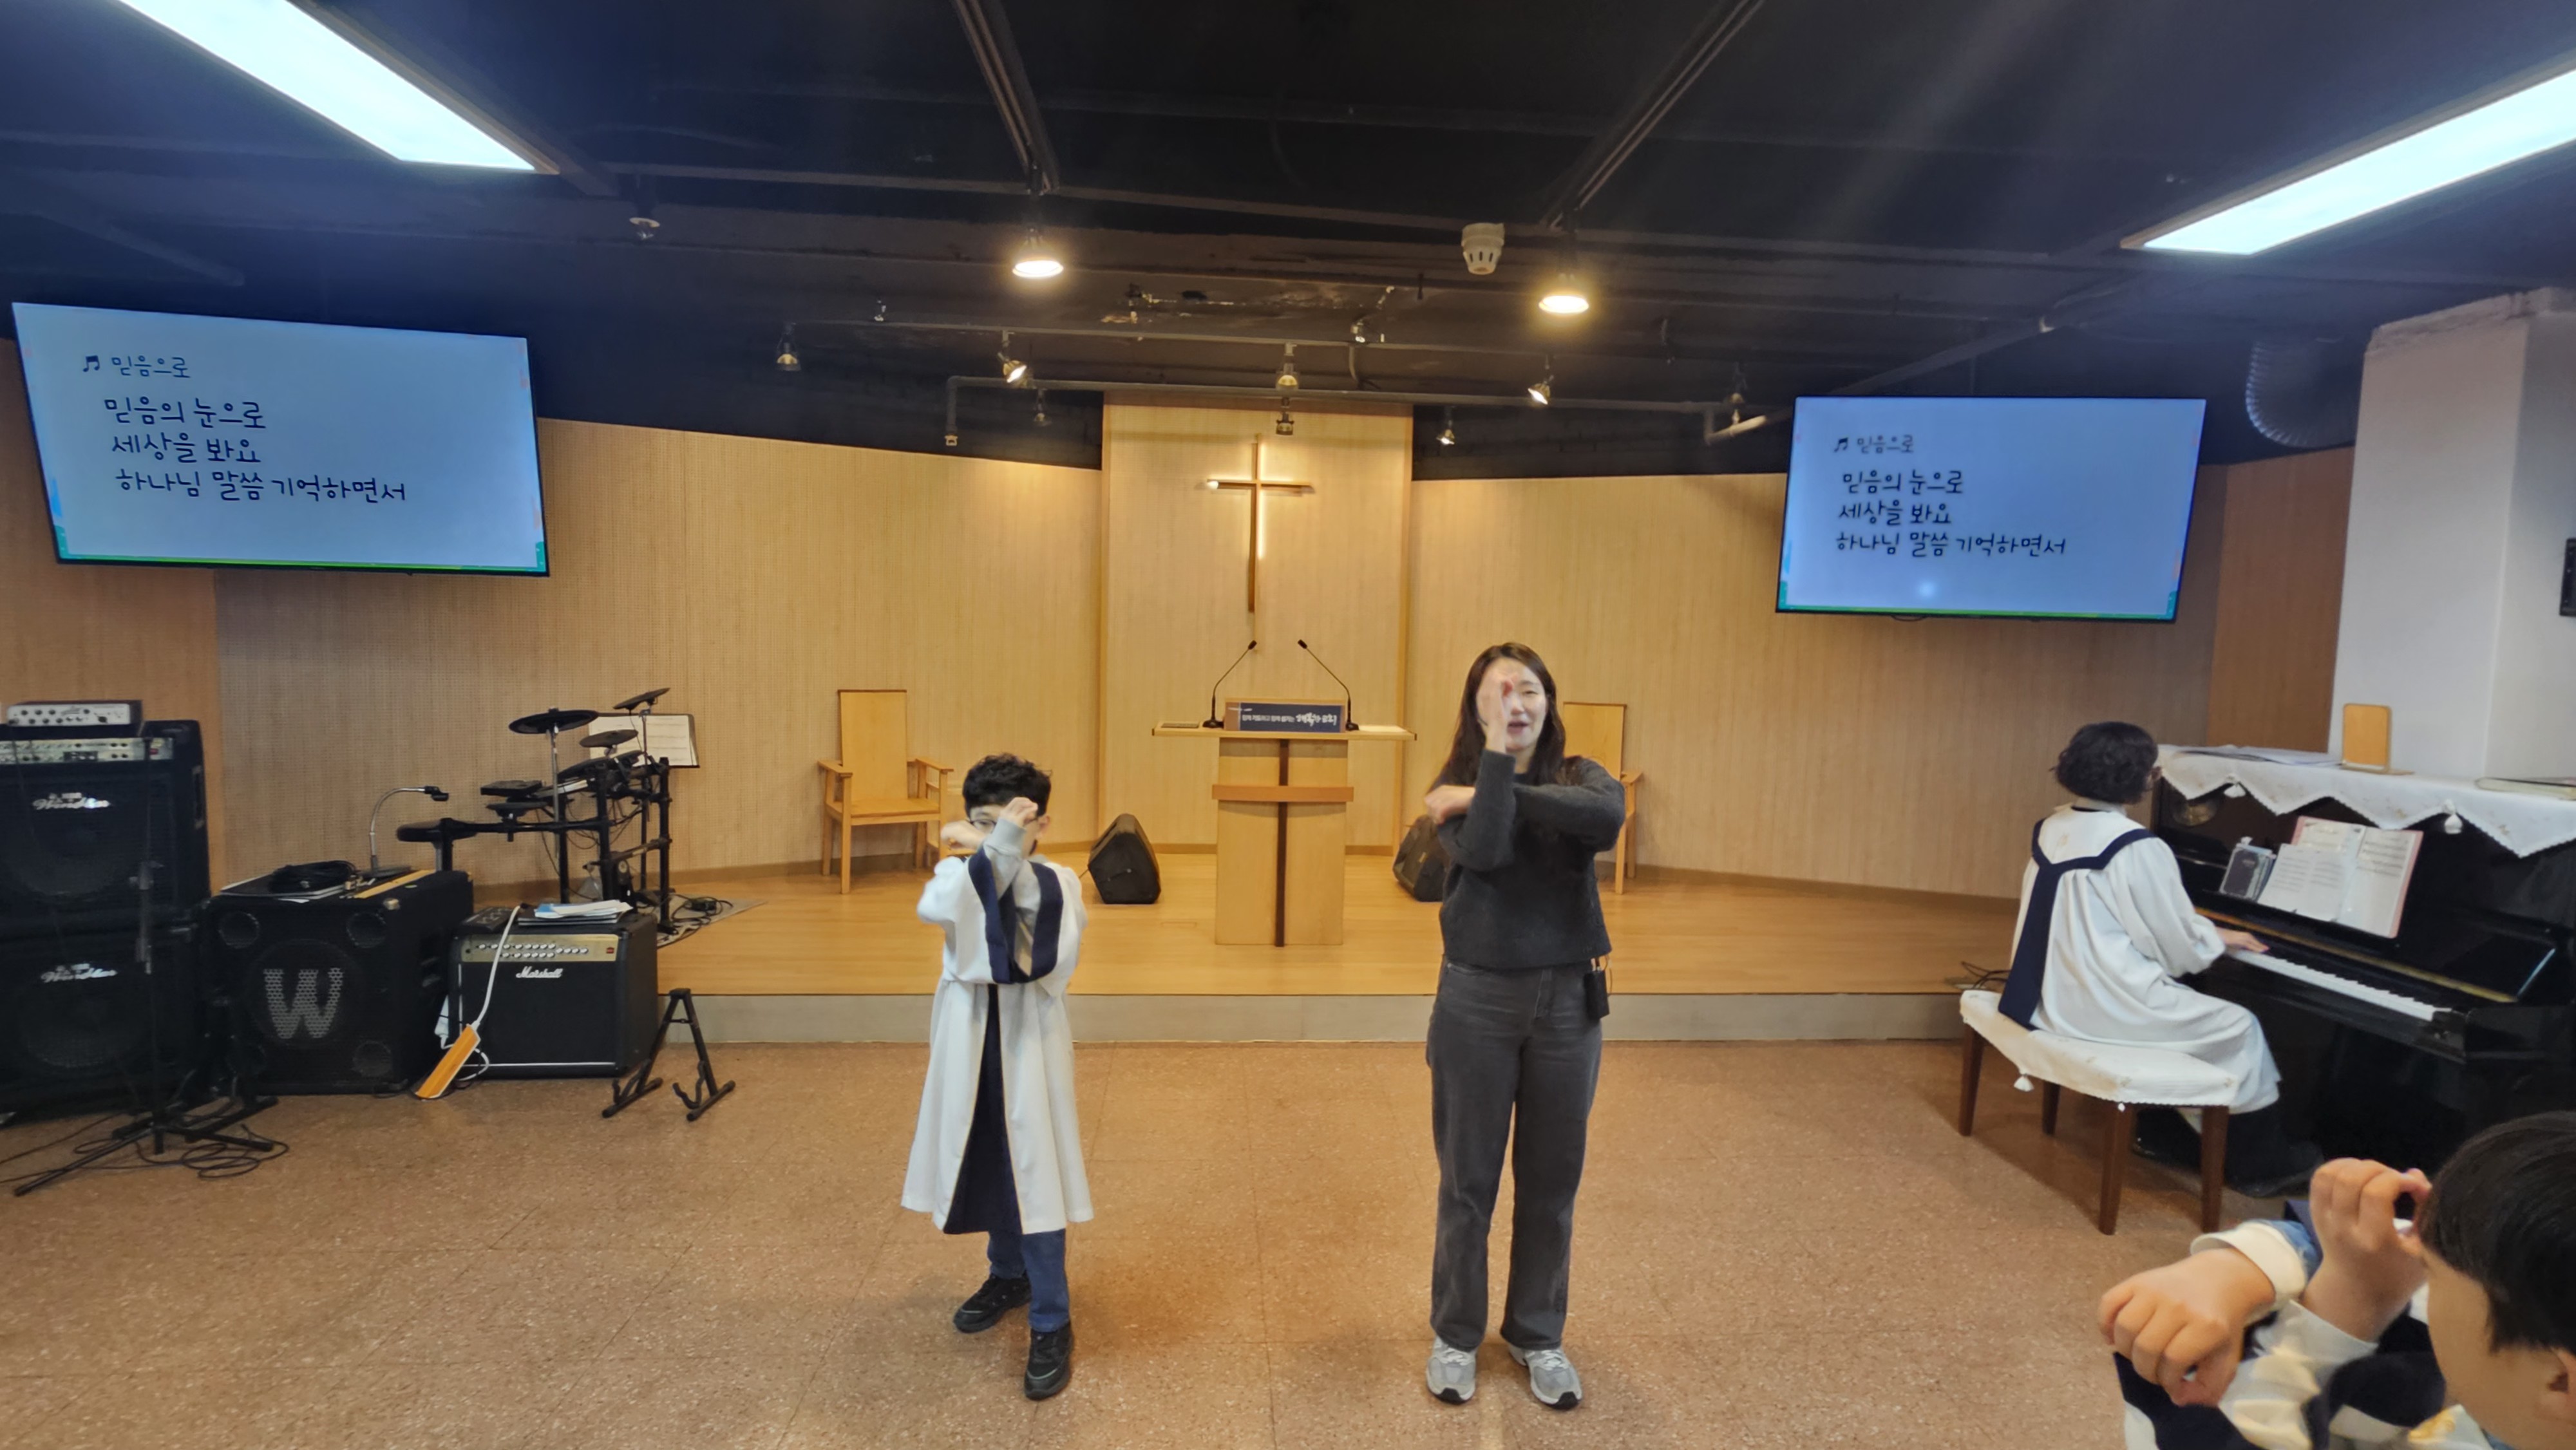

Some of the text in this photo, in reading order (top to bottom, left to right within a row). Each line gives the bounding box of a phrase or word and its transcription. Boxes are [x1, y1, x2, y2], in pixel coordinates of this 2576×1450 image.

[111, 355, 191, 379] 믿음으로
[104, 397, 267, 429] 믿음의 눈으로
[112, 432, 261, 463] 세상을 봐요
[1857, 434, 1914, 454] 믿음으로
[115, 469, 406, 504] 하나님 말씀 기억하면서
[1843, 469, 1963, 495] 믿음의 눈으로
[1839, 500, 1952, 526] 세상을 봐요
[1837, 532, 2066, 558] 하나님 말씀 기억하면서
[515, 966, 564, 979] Marshall
[263, 968, 343, 1039] W
